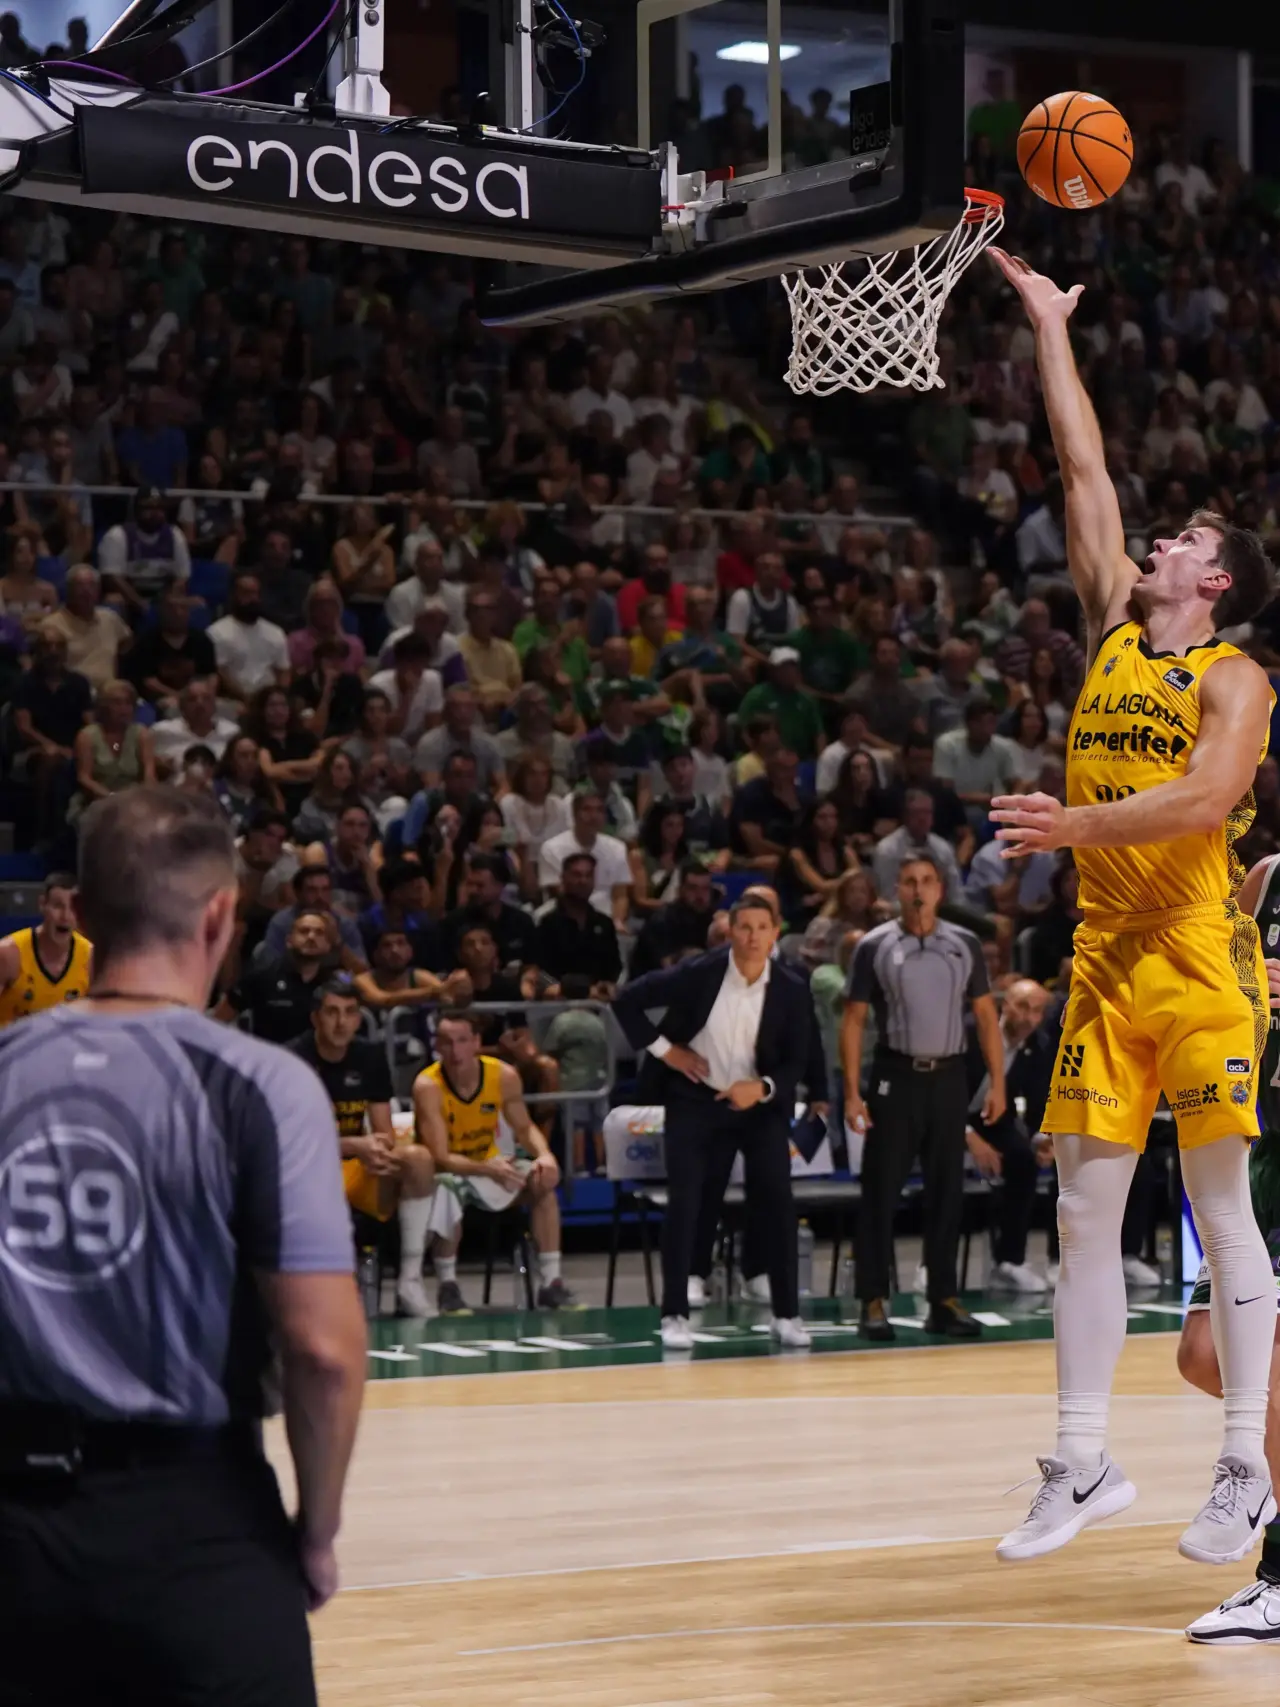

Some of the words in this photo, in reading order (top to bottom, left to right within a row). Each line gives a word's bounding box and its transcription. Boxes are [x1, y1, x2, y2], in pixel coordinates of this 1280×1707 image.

[187, 130, 530, 220] endesa
[1081, 693, 1100, 715] LA
[1228, 1063, 1245, 1072] acb
[1057, 1085, 1118, 1109] Hospiten
[1176, 1088, 1200, 1100] Islas
[6, 1164, 126, 1254] 59
